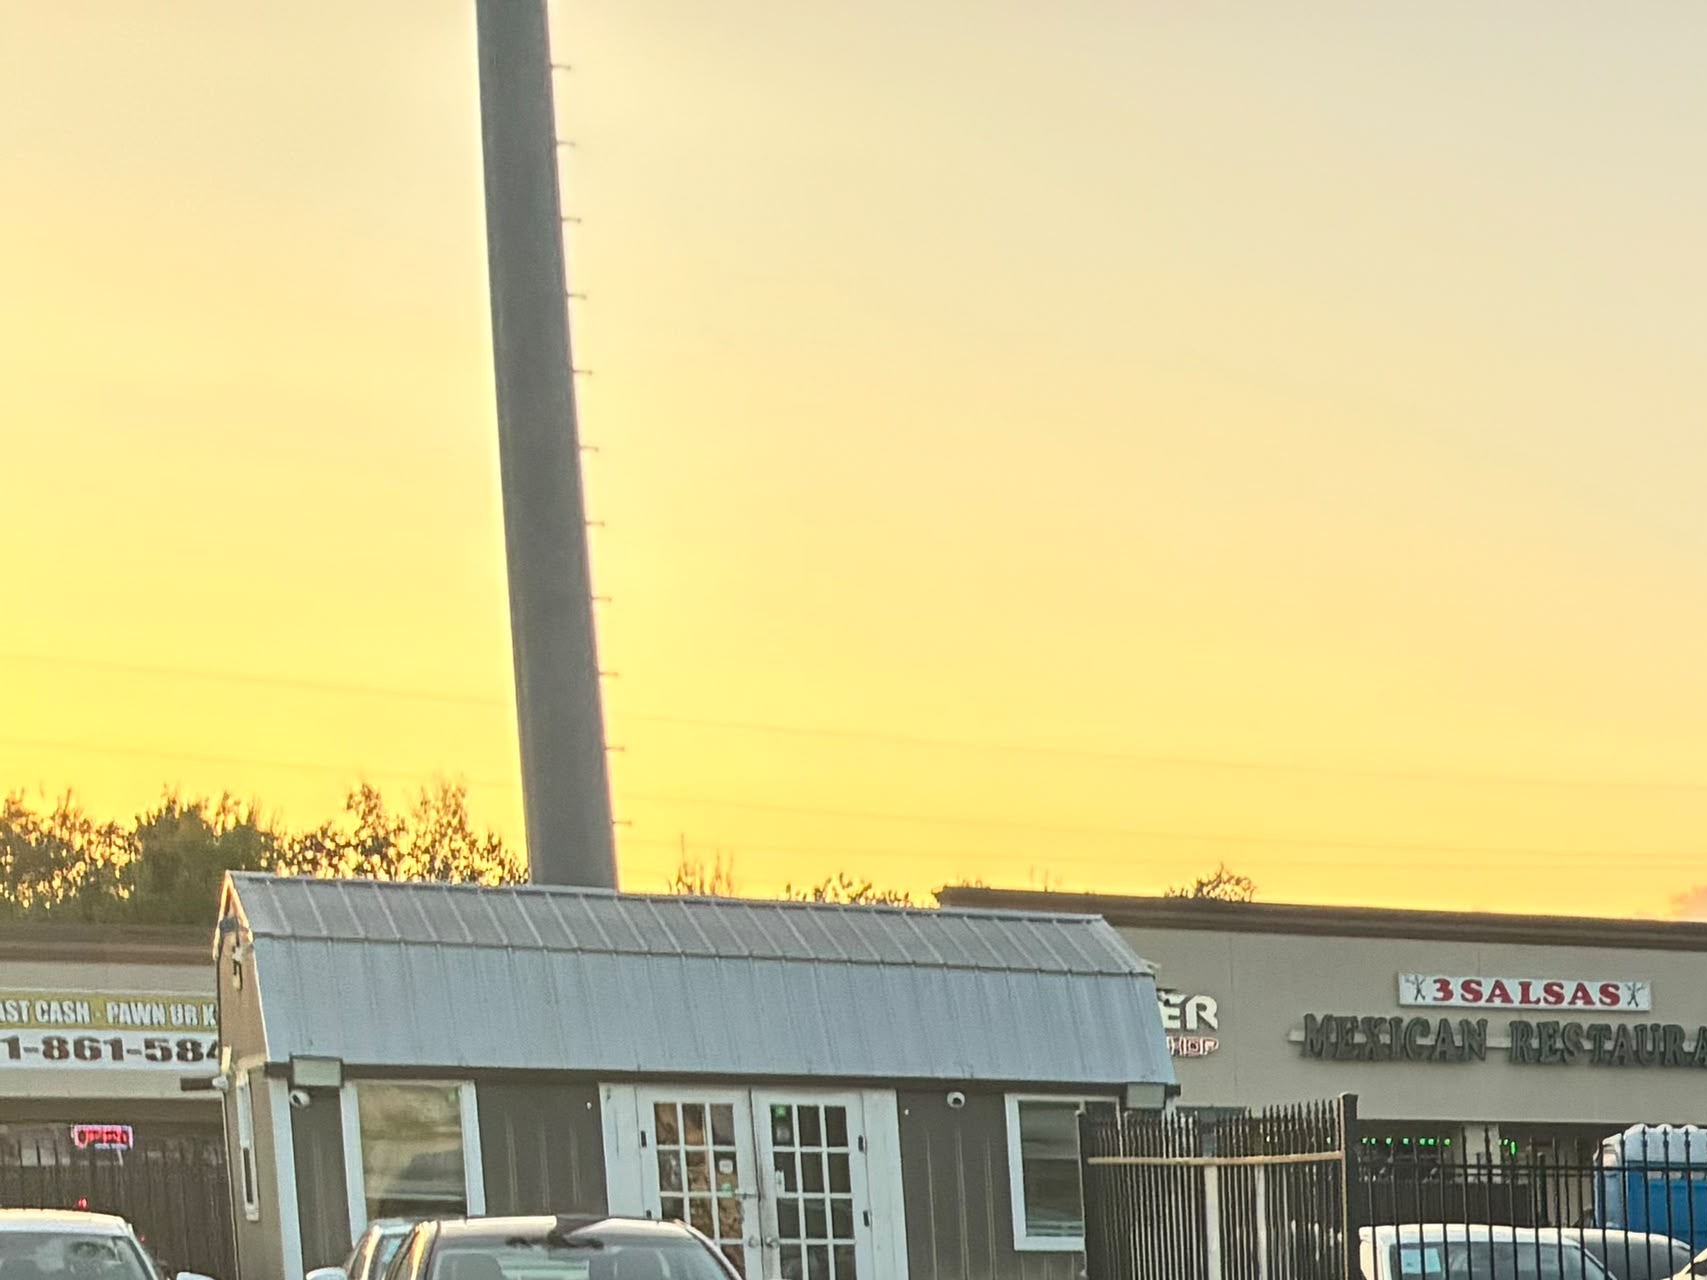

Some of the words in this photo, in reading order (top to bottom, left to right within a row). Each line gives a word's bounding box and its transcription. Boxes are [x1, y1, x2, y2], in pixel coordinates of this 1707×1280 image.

[1432, 978, 1454, 1002] 3
[1460, 978, 1622, 1007] SALSAS
[35, 1000, 91, 1024] CASH
[106, 1002, 166, 1025] PAWN
[1301, 1013, 1488, 1062] MEXICAN
